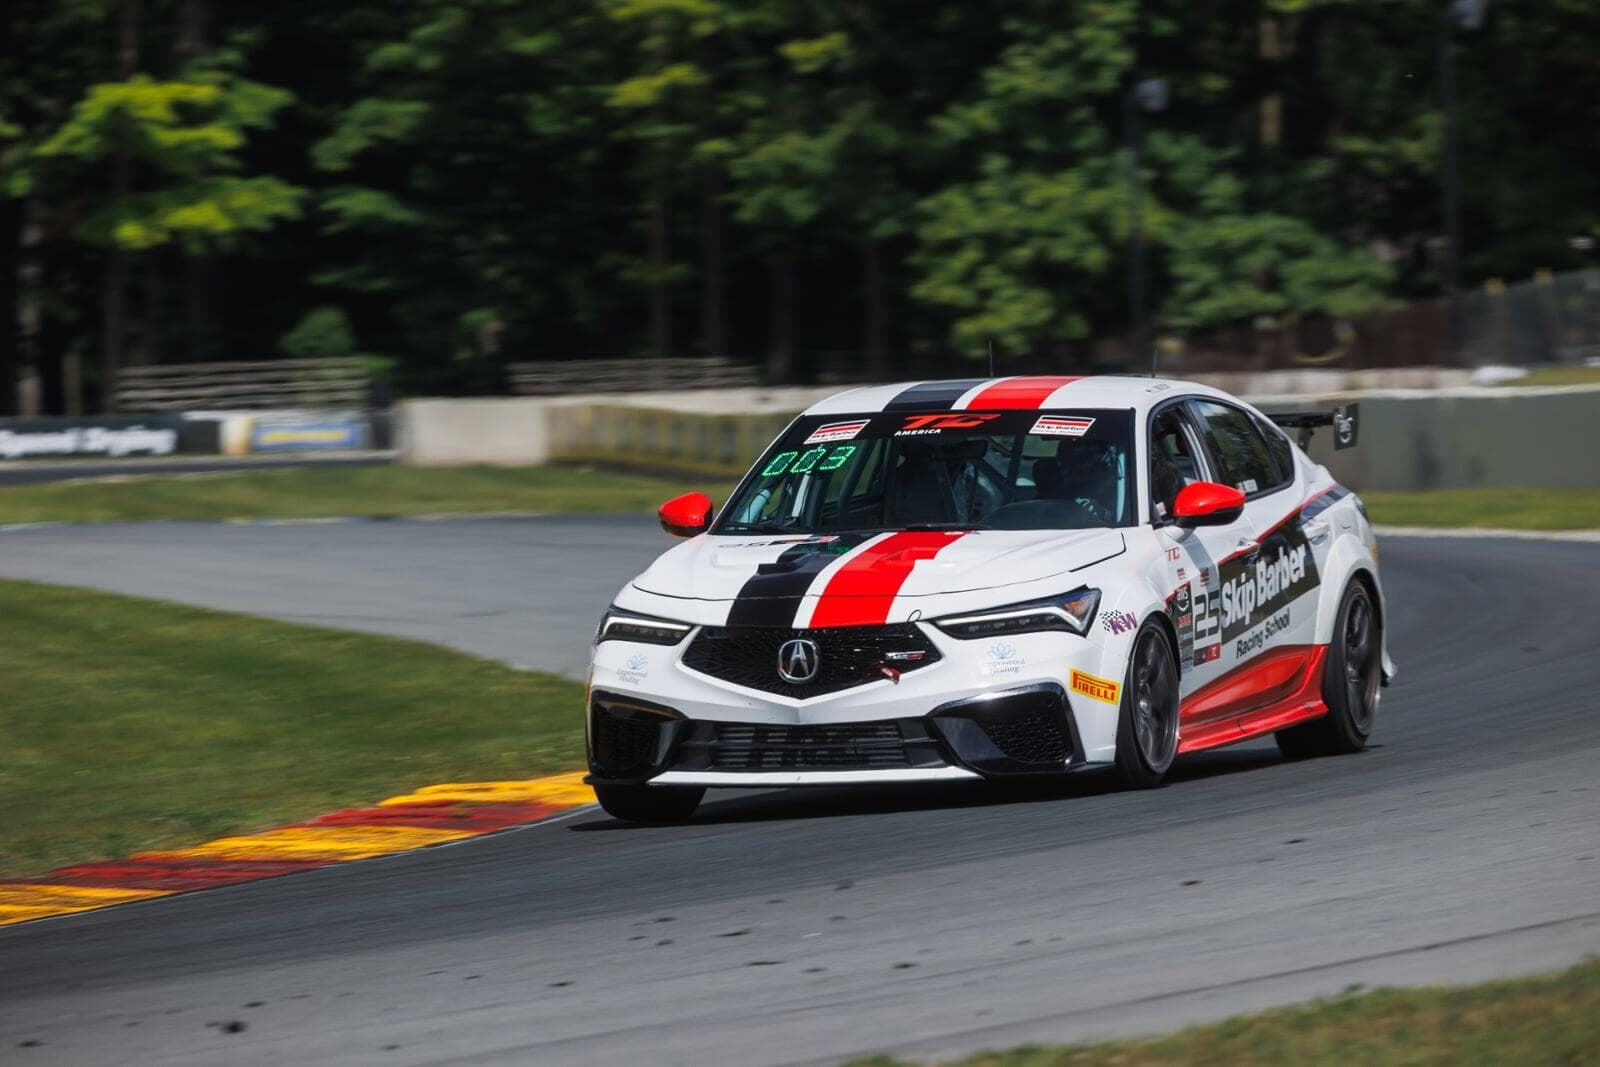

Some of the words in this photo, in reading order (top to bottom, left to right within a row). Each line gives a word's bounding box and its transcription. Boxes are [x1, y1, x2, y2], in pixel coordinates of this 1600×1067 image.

[894, 428, 942, 436] AMERICA
[1165, 547, 1180, 561] TC
[1221, 572, 1257, 629] Skip
[1256, 544, 1306, 607] Barber
[1108, 612, 1138, 635] KW
[1236, 628, 1263, 660] Racing
[1264, 608, 1290, 640] School
[1072, 671, 1116, 701] PIRELLI
